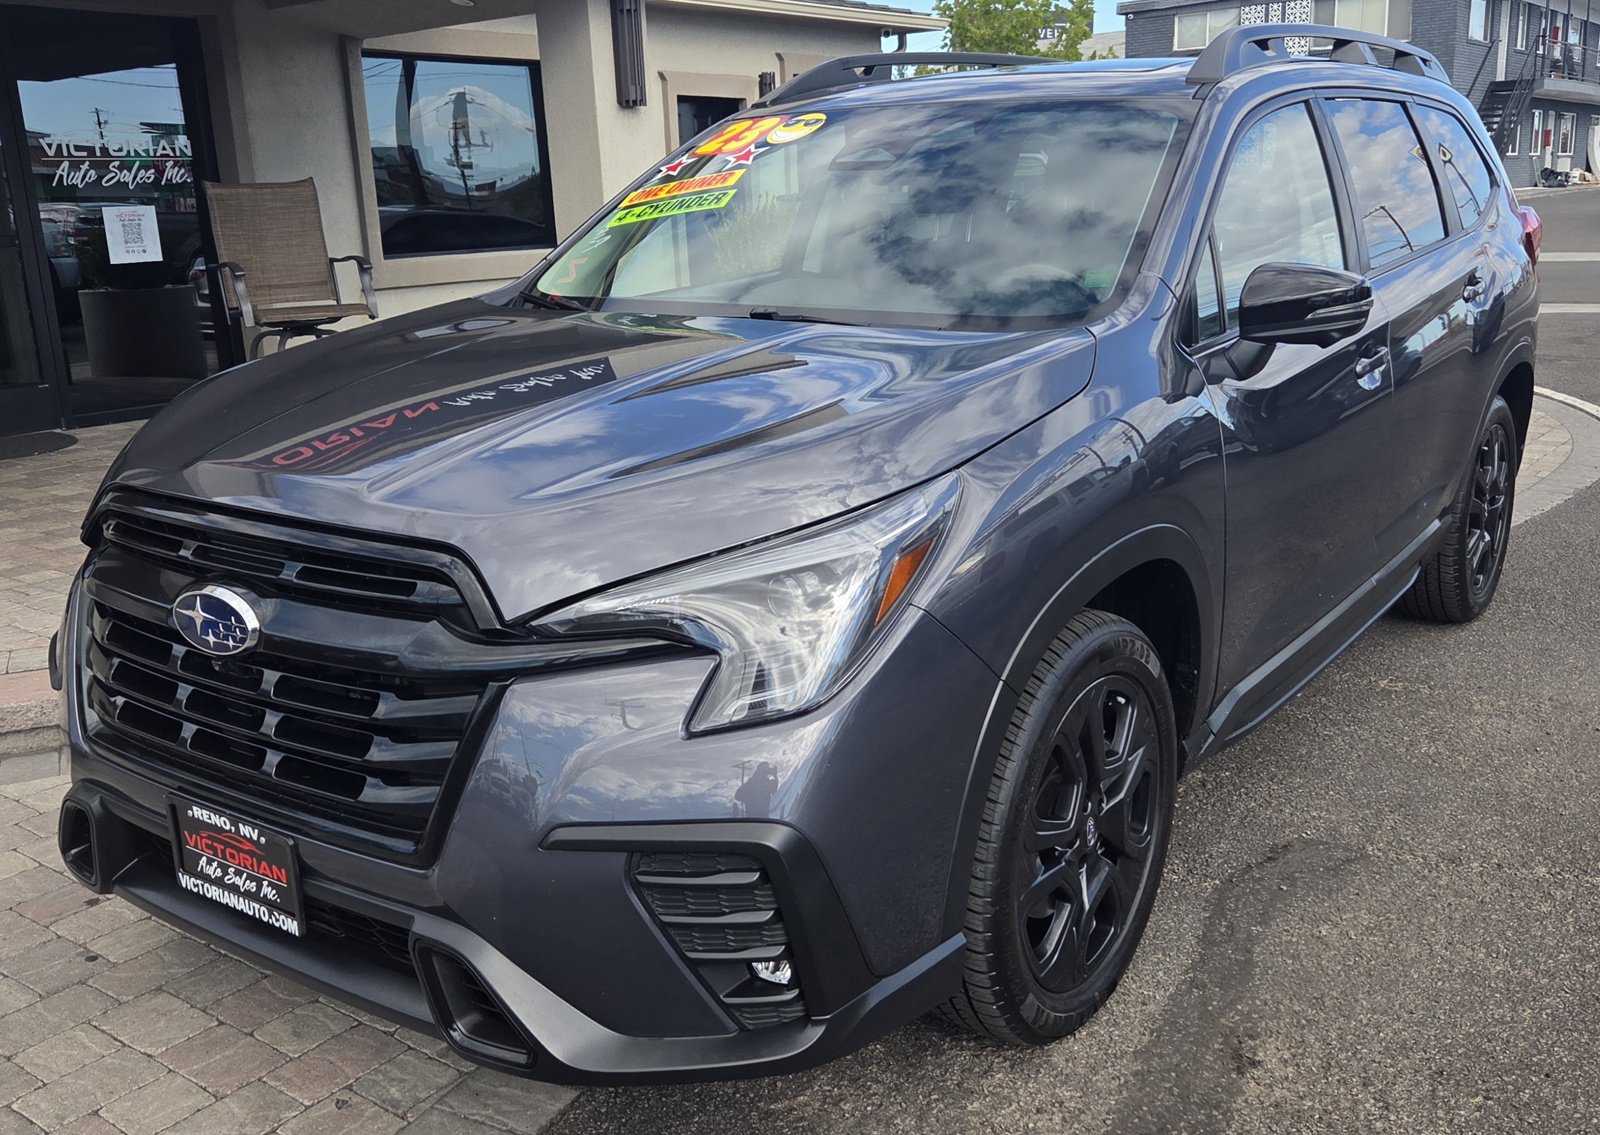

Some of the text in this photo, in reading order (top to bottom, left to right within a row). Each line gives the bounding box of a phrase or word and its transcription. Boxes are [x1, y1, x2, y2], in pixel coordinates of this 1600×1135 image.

[39, 138, 192, 157] VICTORIAN
[693, 116, 783, 155] 23
[52, 160, 97, 189] Auto
[102, 160, 155, 190] Sales
[161, 160, 192, 186] Inc.
[628, 171, 737, 203] ONE OWNER
[617, 191, 730, 223] 4-CYLINDER
[192, 805, 258, 840] RENO, NV
[184, 830, 288, 884] VICTORIAN
[197, 856, 281, 903] Auto Sales Inc.
[178, 872, 300, 937] VICTORIANAUTO.COM
